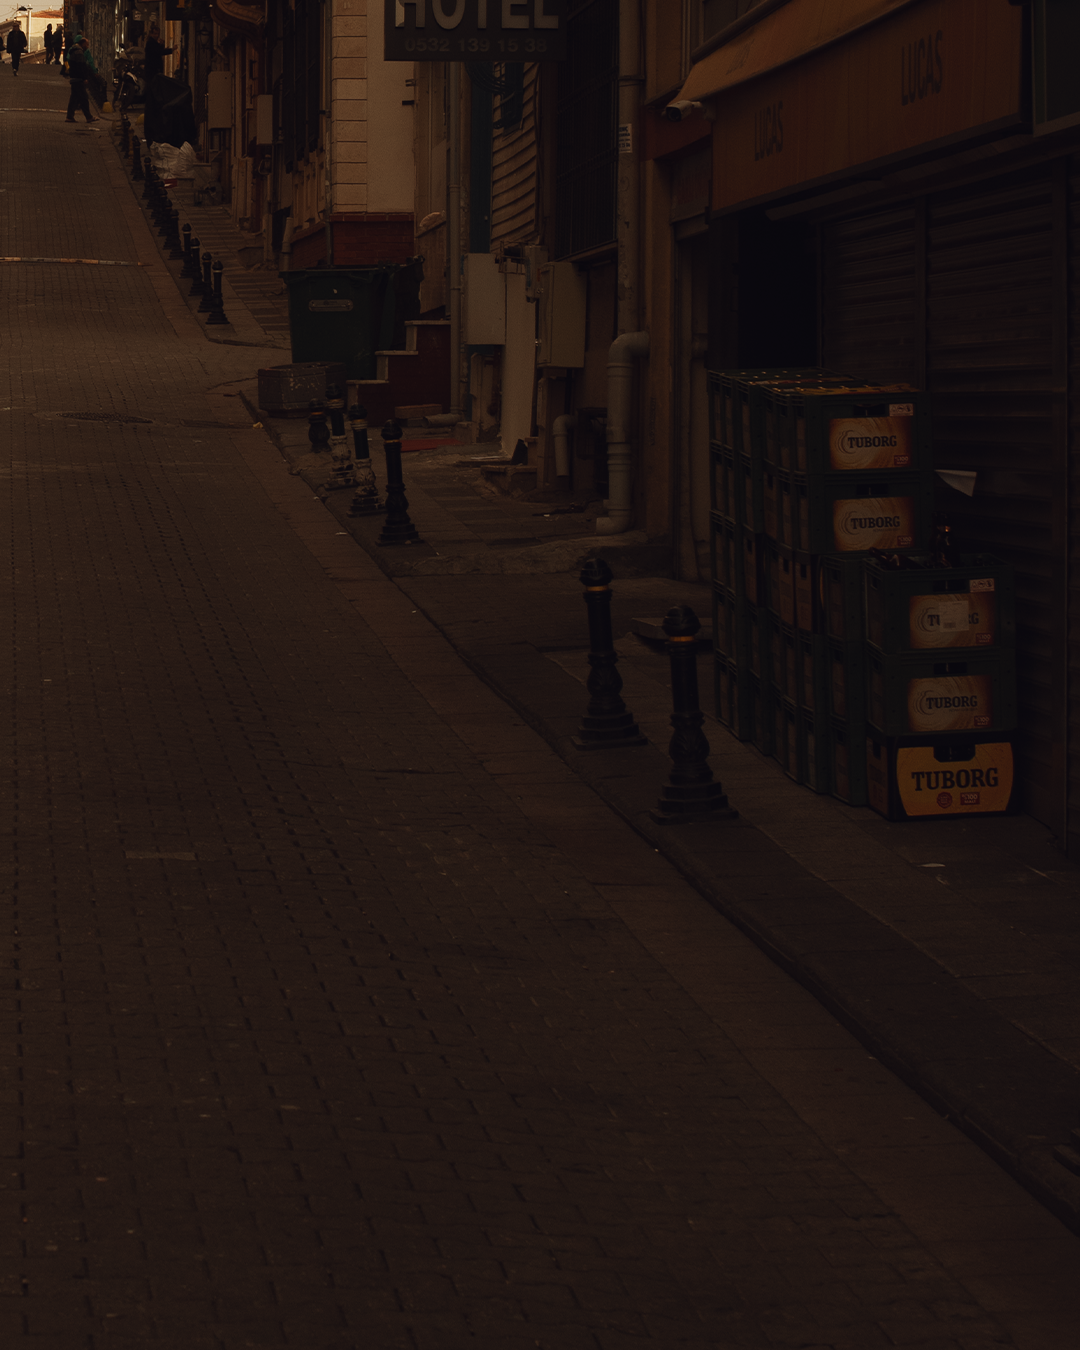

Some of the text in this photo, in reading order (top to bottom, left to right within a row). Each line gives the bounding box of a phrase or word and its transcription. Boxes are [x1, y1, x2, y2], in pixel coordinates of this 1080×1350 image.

[404, 37, 548, 53] 0532 139 15 38
[901, 29, 943, 106] LUCAS
[754, 100, 783, 162] LUCAS
[848, 435, 897, 449] TUBORG
[851, 515, 900, 530] TUBORG
[926, 695, 978, 710] TUBORG
[911, 767, 999, 792] TUBORG
